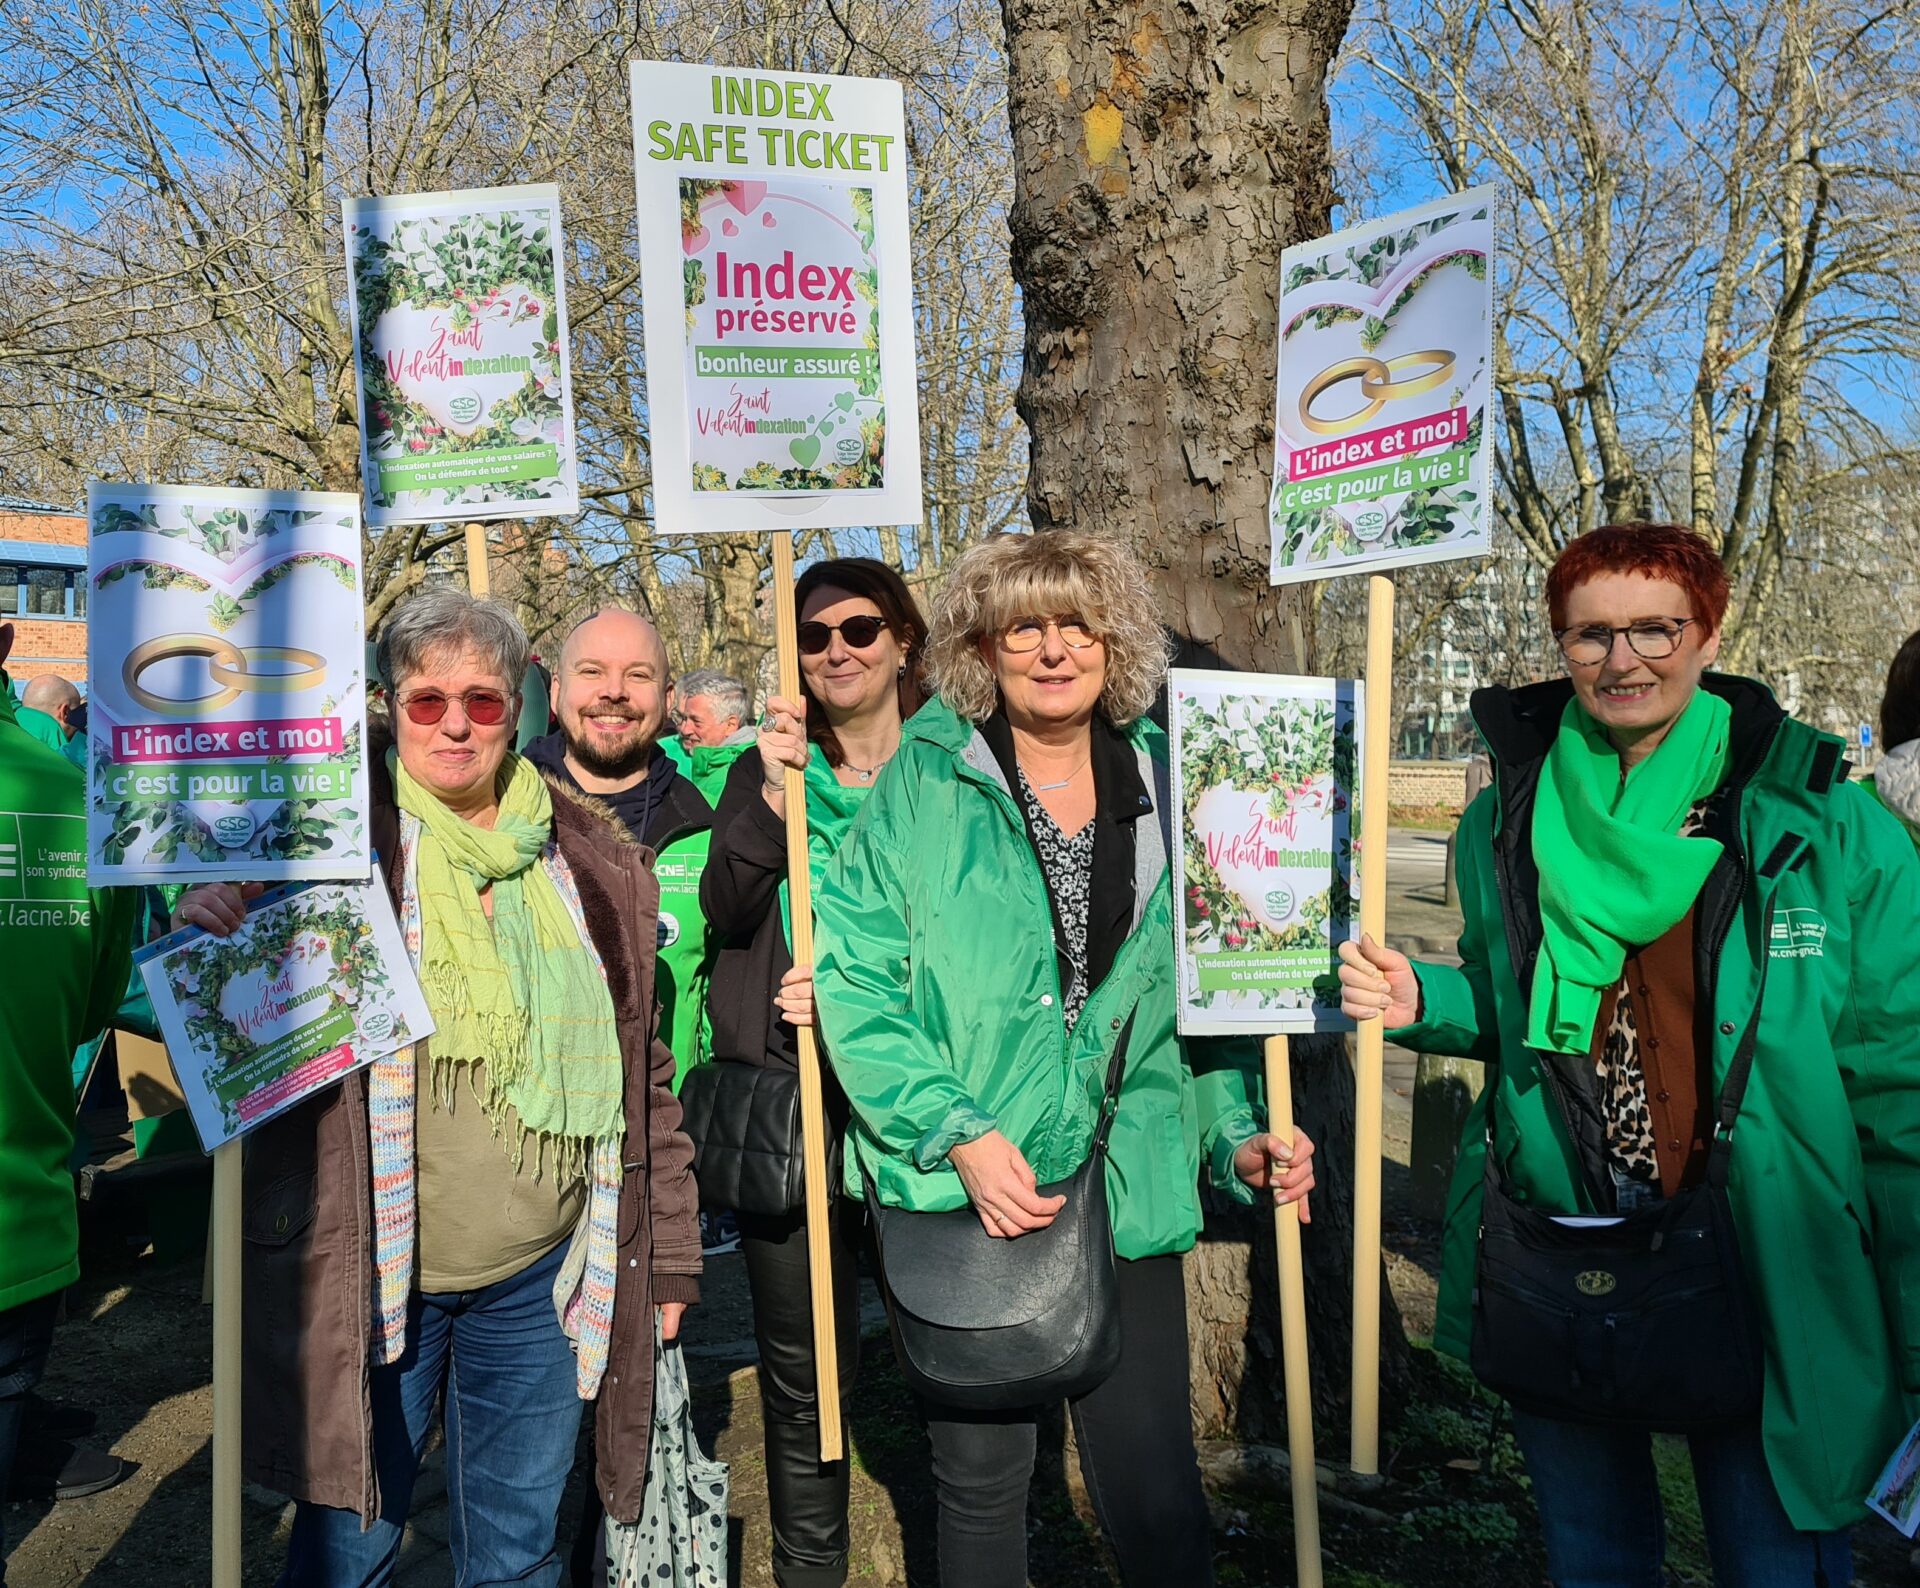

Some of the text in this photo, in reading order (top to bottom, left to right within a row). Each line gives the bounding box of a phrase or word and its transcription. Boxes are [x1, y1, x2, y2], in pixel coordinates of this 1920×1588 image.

[711, 75, 834, 121] INDEX
[648, 120, 895, 171] SAFE TICKET
[716, 250, 856, 301] Index
[715, 300, 856, 339] préservé
[427, 315, 483, 359] Saint
[387, 348, 530, 382] Valentindexation
[698, 352, 788, 374] bonheur
[793, 352, 860, 375] assuré
[727, 382, 771, 417] Saint
[697, 408, 806, 437] Valentindexation
[1295, 410, 1458, 475] L'index et moi
[380, 461, 430, 473] L'indexation
[432, 457, 484, 468] automatique
[485, 454, 496, 463] de
[497, 453, 512, 462] vos
[513, 450, 546, 460] salaires
[415, 465, 509, 481] On la défendra de tout
[1285, 483, 1332, 508] c'est
[1337, 473, 1388, 504] pour
[1393, 467, 1412, 488] la
[1419, 457, 1452, 482] vie
[1355, 512, 1383, 526] CSC
[121, 720, 332, 756] L'index et moi
[113, 770, 180, 795] c'est
[188, 775, 252, 800] pour
[261, 769, 284, 793] la
[292, 767, 332, 793] vie
[215, 816, 250, 831] CSC
[1244, 799, 1298, 845] Saint
[38, 848, 81, 862] L'avenir
[656, 865, 684, 877] CNE
[27, 865, 86, 880] son syndica
[0, 903, 91, 927] .lacne.be
[1198, 957, 1245, 968] L'indexation
[1247, 956, 1295, 967] automatique
[1297, 955, 1308, 964] de
[1232, 969, 1320, 980] On la défendra de tout
[258, 970, 294, 1008] Saint
[238, 981, 332, 1034] Valentindexation
[363, 1013, 390, 1030] CSC
[213, 1060, 254, 1087] L'indexation
[252, 1037, 294, 1064] automatique
[291, 1032, 303, 1042] de
[302, 1027, 315, 1037] vos
[314, 1011, 342, 1031] salaires
[243, 1036, 316, 1082] On la défendra de tout
